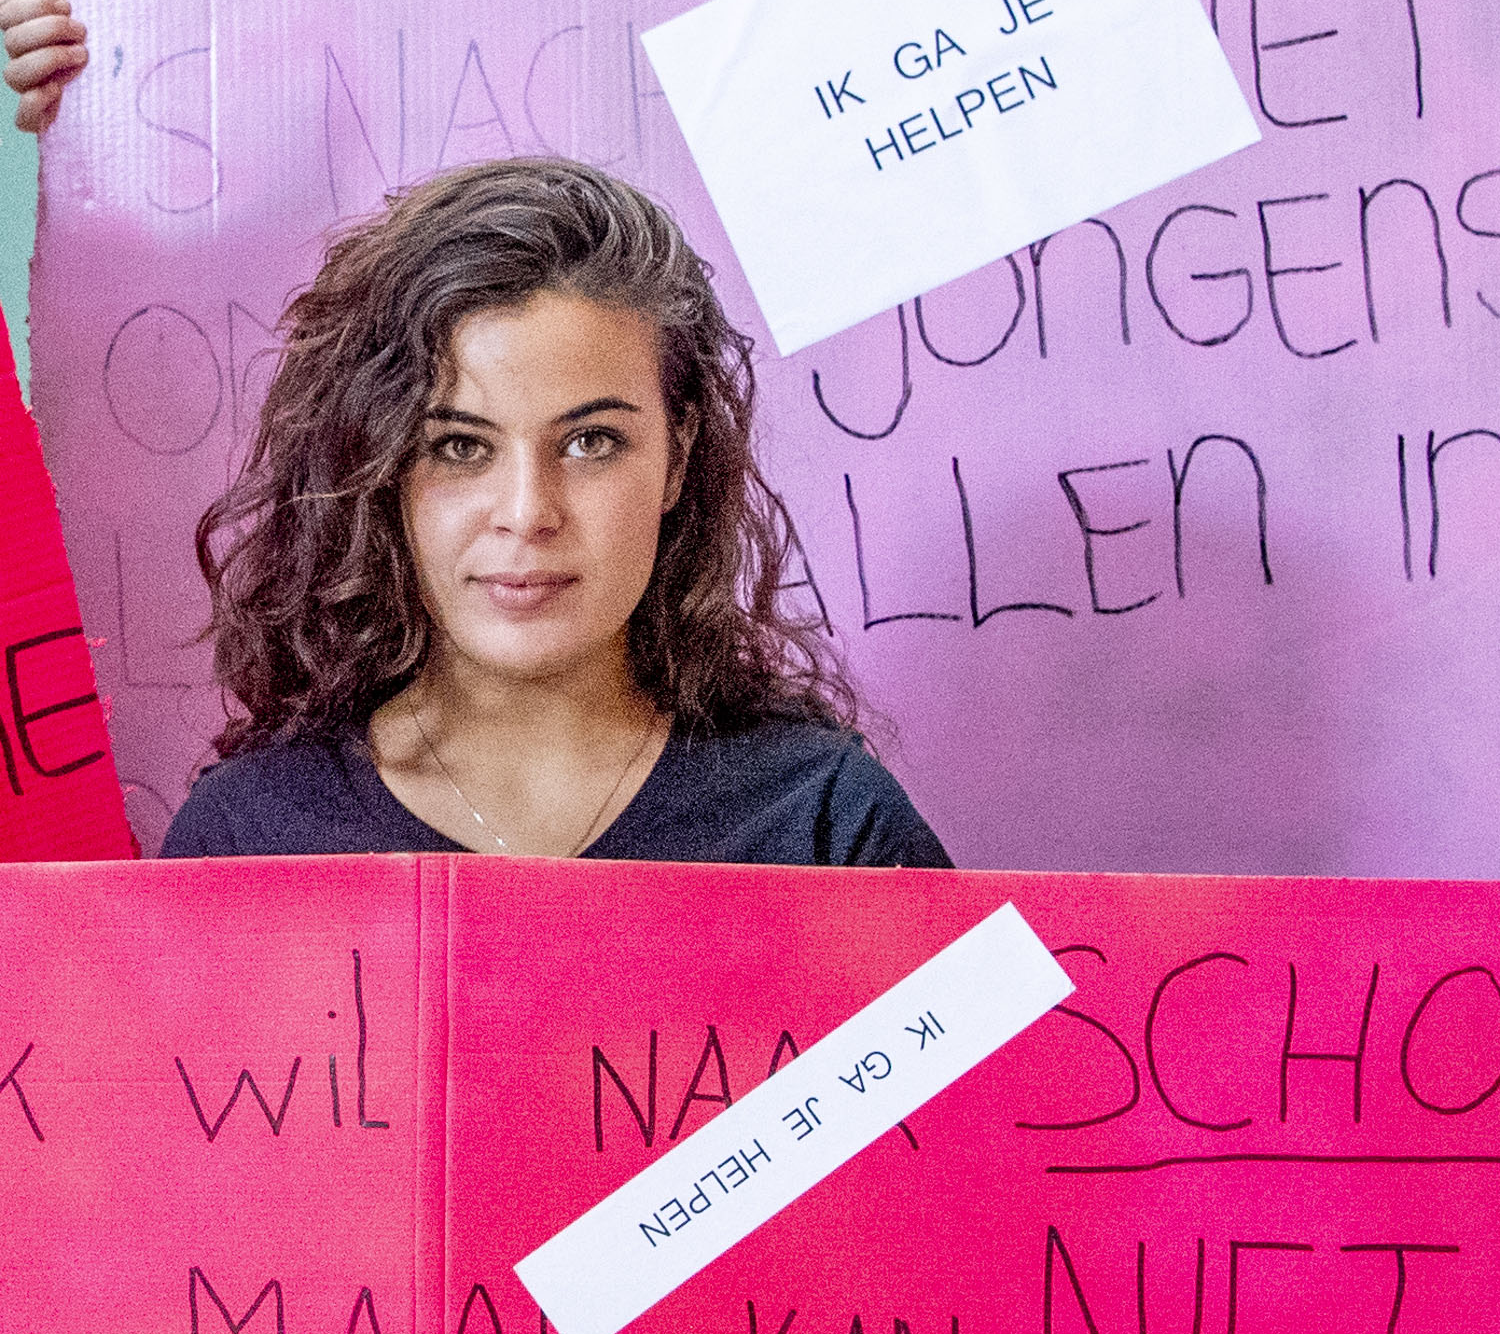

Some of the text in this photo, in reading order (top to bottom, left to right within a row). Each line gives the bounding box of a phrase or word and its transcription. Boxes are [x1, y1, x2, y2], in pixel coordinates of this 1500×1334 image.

[813, 72, 866, 120] IK
[892, 28, 966, 80] GA
[864, 56, 1058, 171] HELPEN
[638, 1009, 946, 1248] IK GA JE HELPEN
